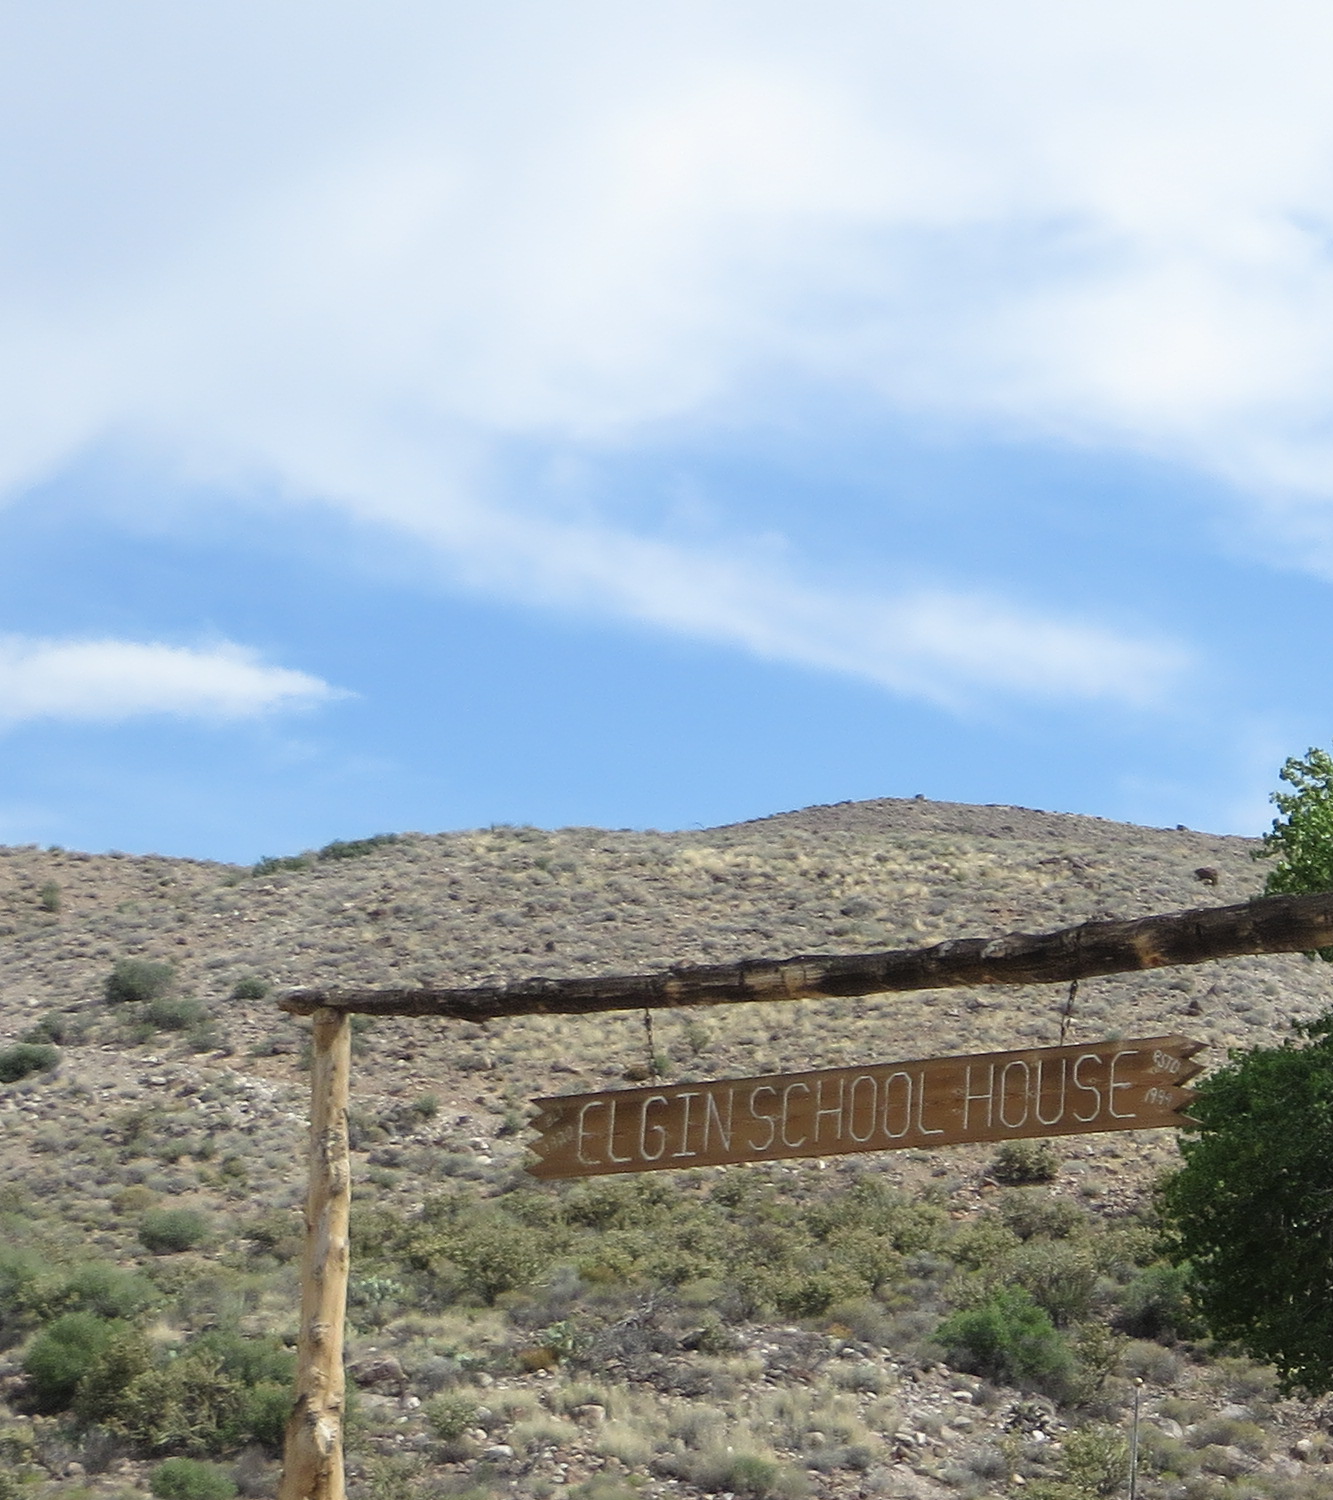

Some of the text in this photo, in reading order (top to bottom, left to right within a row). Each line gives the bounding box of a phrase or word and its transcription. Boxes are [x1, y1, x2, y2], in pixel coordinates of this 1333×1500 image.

[577, 1050, 1139, 1165] ELGIN SCHOOL HOUSE
